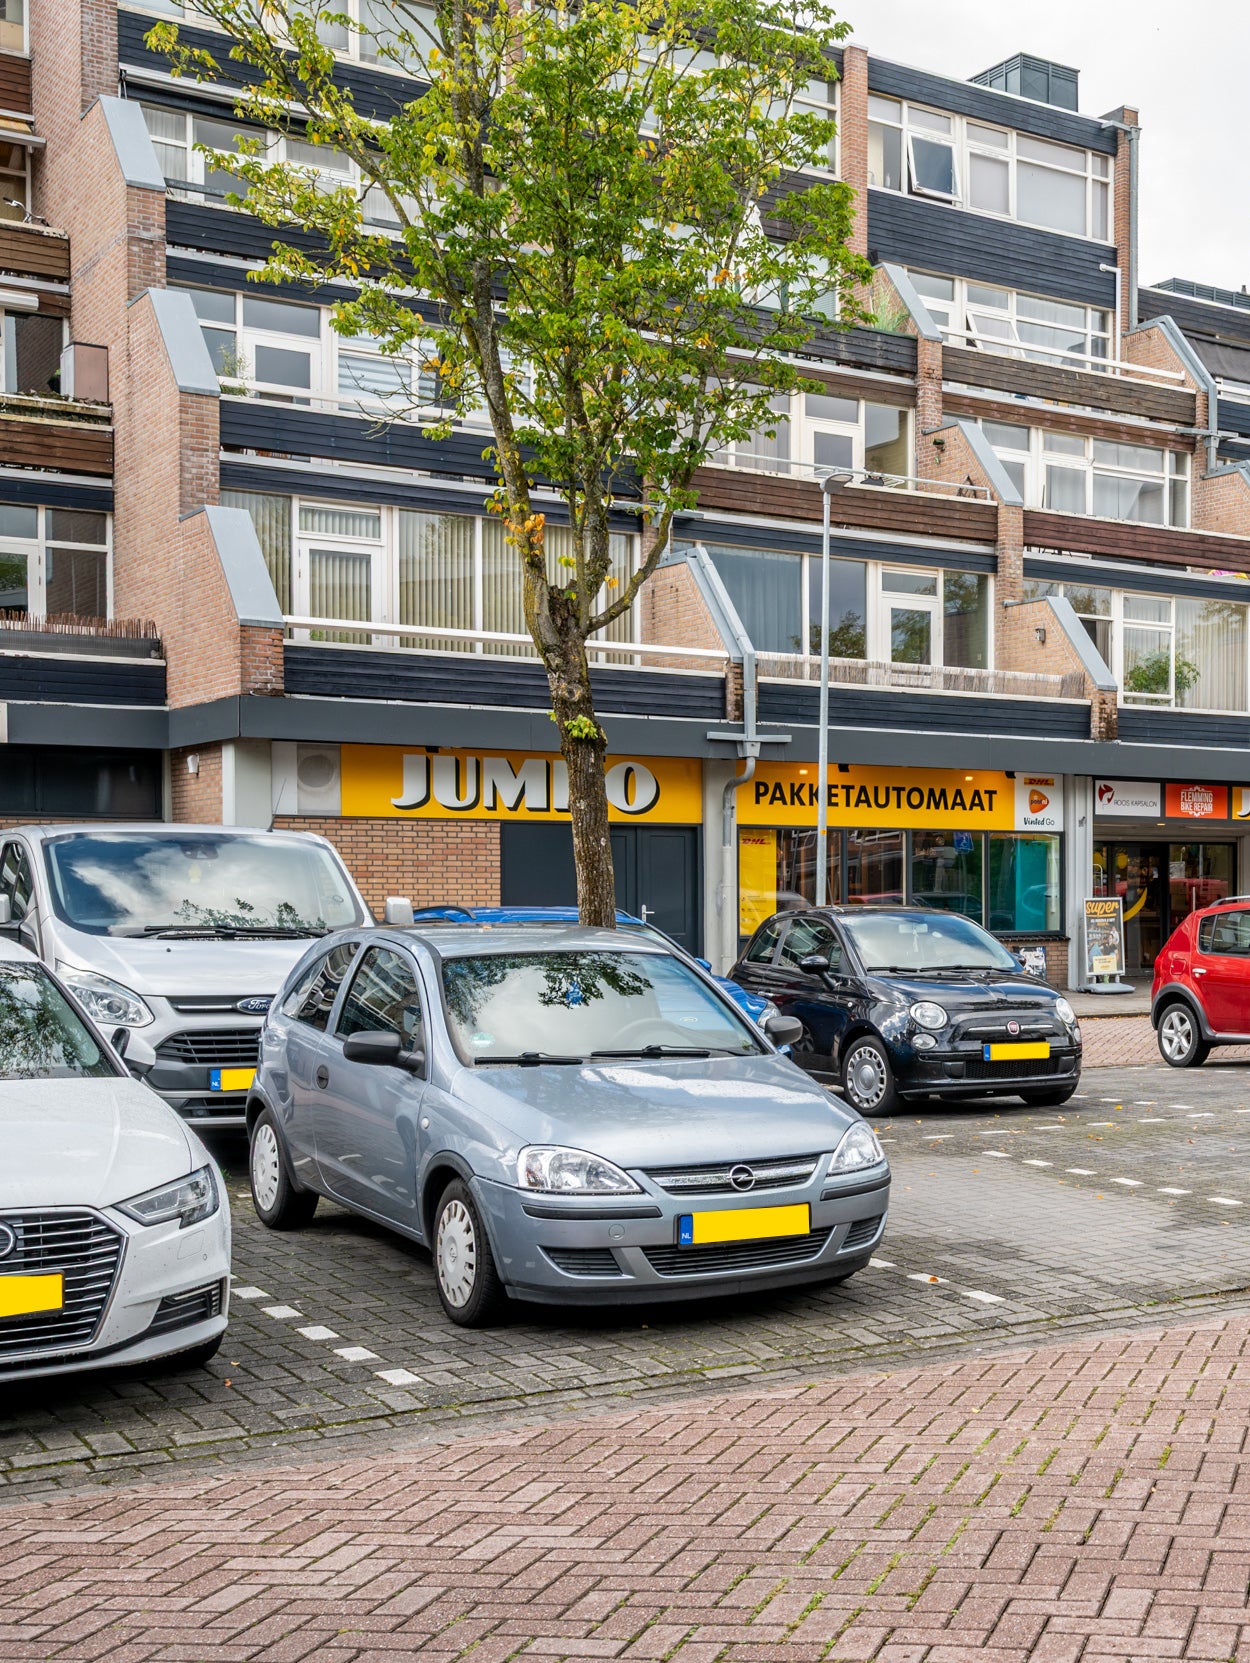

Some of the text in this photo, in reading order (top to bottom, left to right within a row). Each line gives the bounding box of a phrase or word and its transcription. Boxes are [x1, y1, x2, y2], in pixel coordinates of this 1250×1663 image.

[390, 754, 660, 815] JUMO
[754, 781, 998, 812] PAKKETAUTOMAAT
[1180, 791, 1213, 802] FLEMMING
[1180, 802, 1213, 812] BIKE REPAIR
[1024, 817, 1055, 826] Vinted Go
[1086, 901, 1119, 916] super
[681, 1232, 692, 1240] NL
